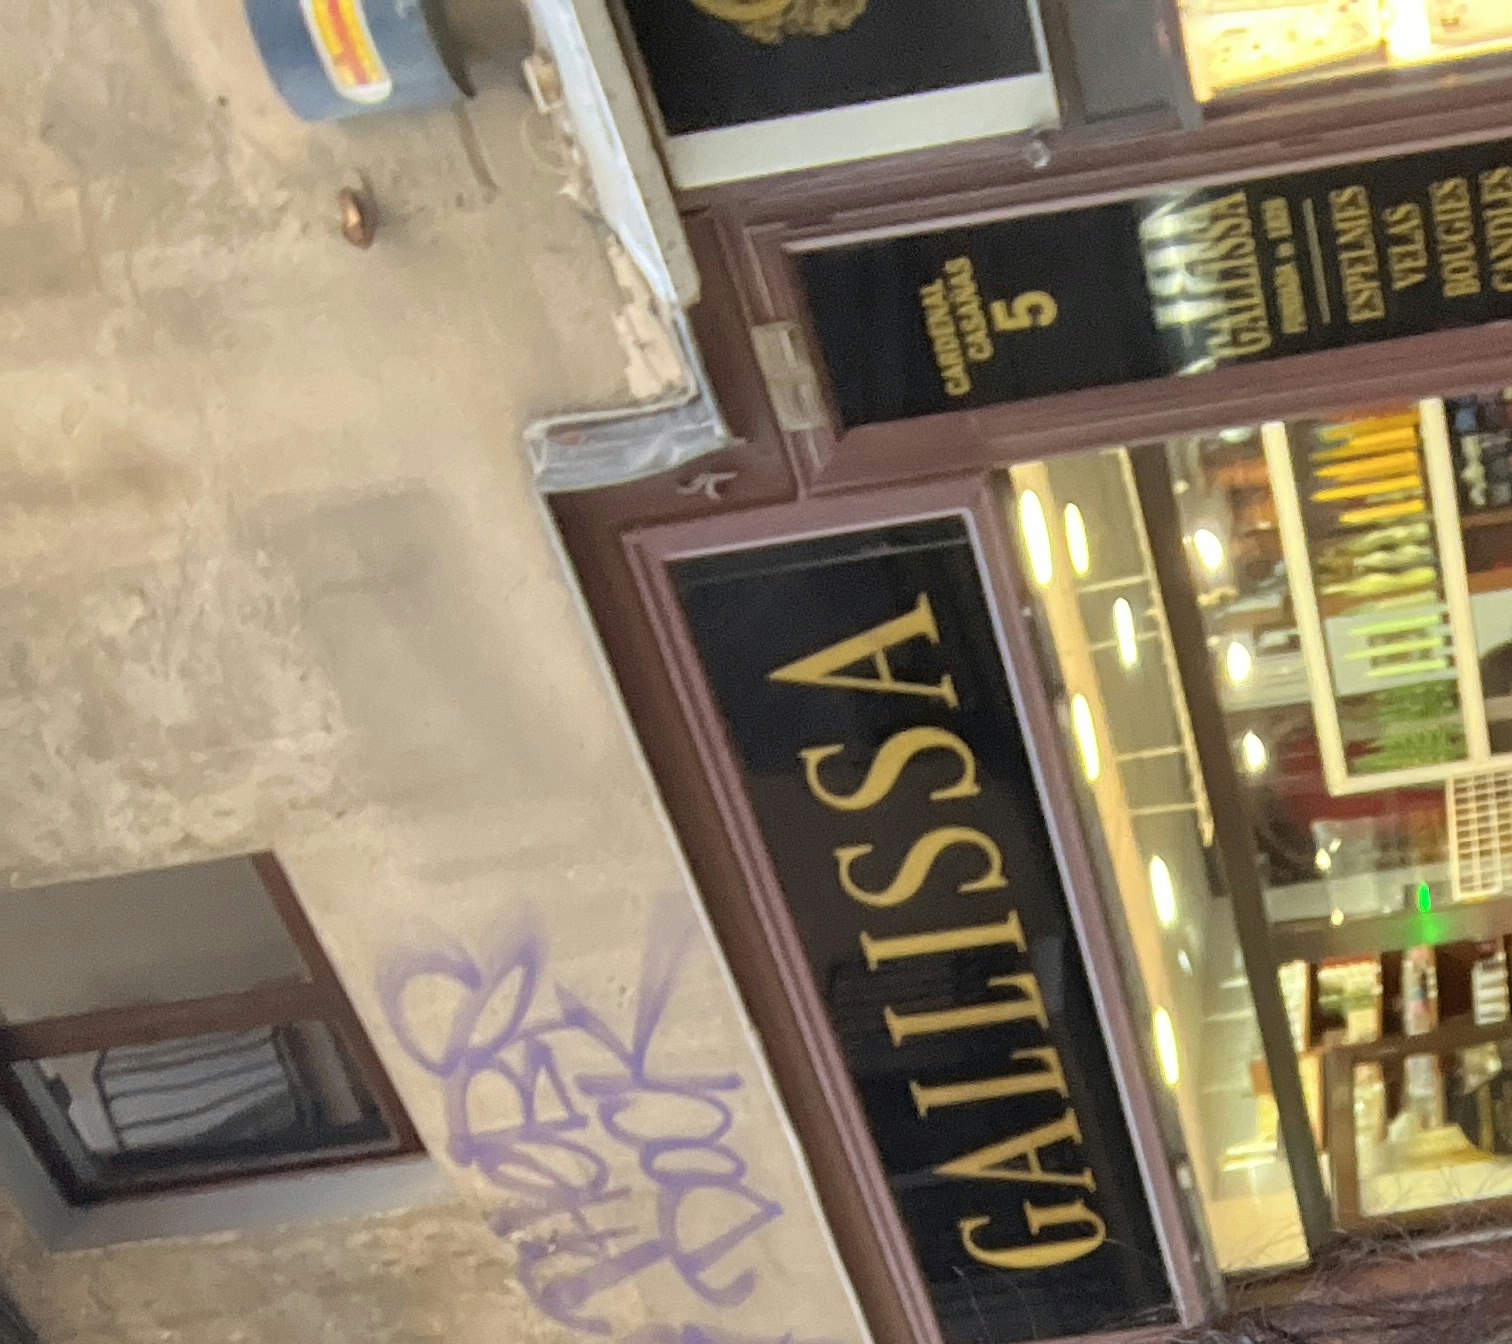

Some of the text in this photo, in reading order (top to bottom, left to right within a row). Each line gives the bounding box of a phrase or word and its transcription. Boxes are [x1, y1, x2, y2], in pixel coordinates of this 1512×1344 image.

[1330, 185, 1386, 323] ESPELMES
[1383, 202, 1428, 292] VELAS
[1429, 176, 1482, 298] BOUGIES
[990, 290, 1058, 332] 5
[768, 592, 1108, 1270] GALLISSA
